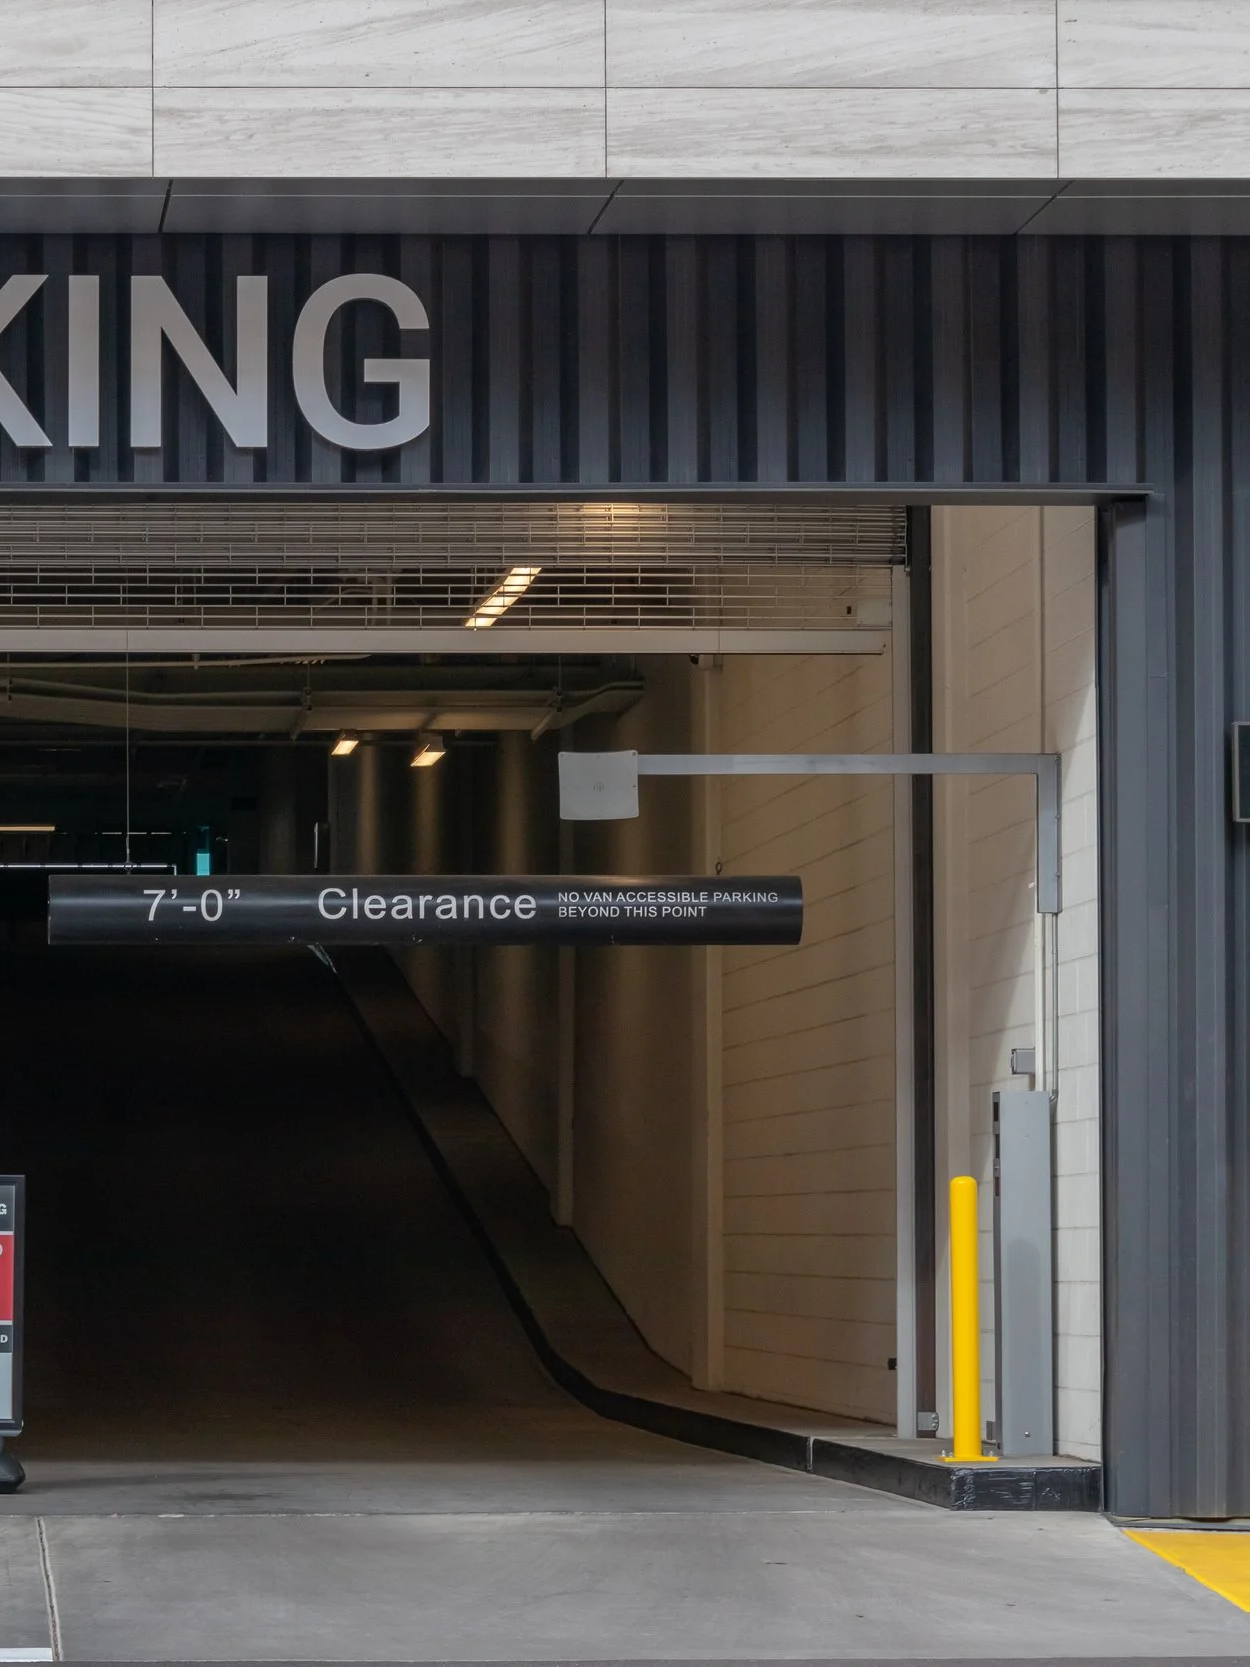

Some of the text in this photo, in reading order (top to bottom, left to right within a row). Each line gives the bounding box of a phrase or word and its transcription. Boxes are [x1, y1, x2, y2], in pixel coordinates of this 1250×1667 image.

[316, 888, 536, 919] Clearance
[559, 892, 778, 903] NO VAN ACCESSIBLE PARKING
[559, 906, 706, 918] BEYOND THIS POINT
